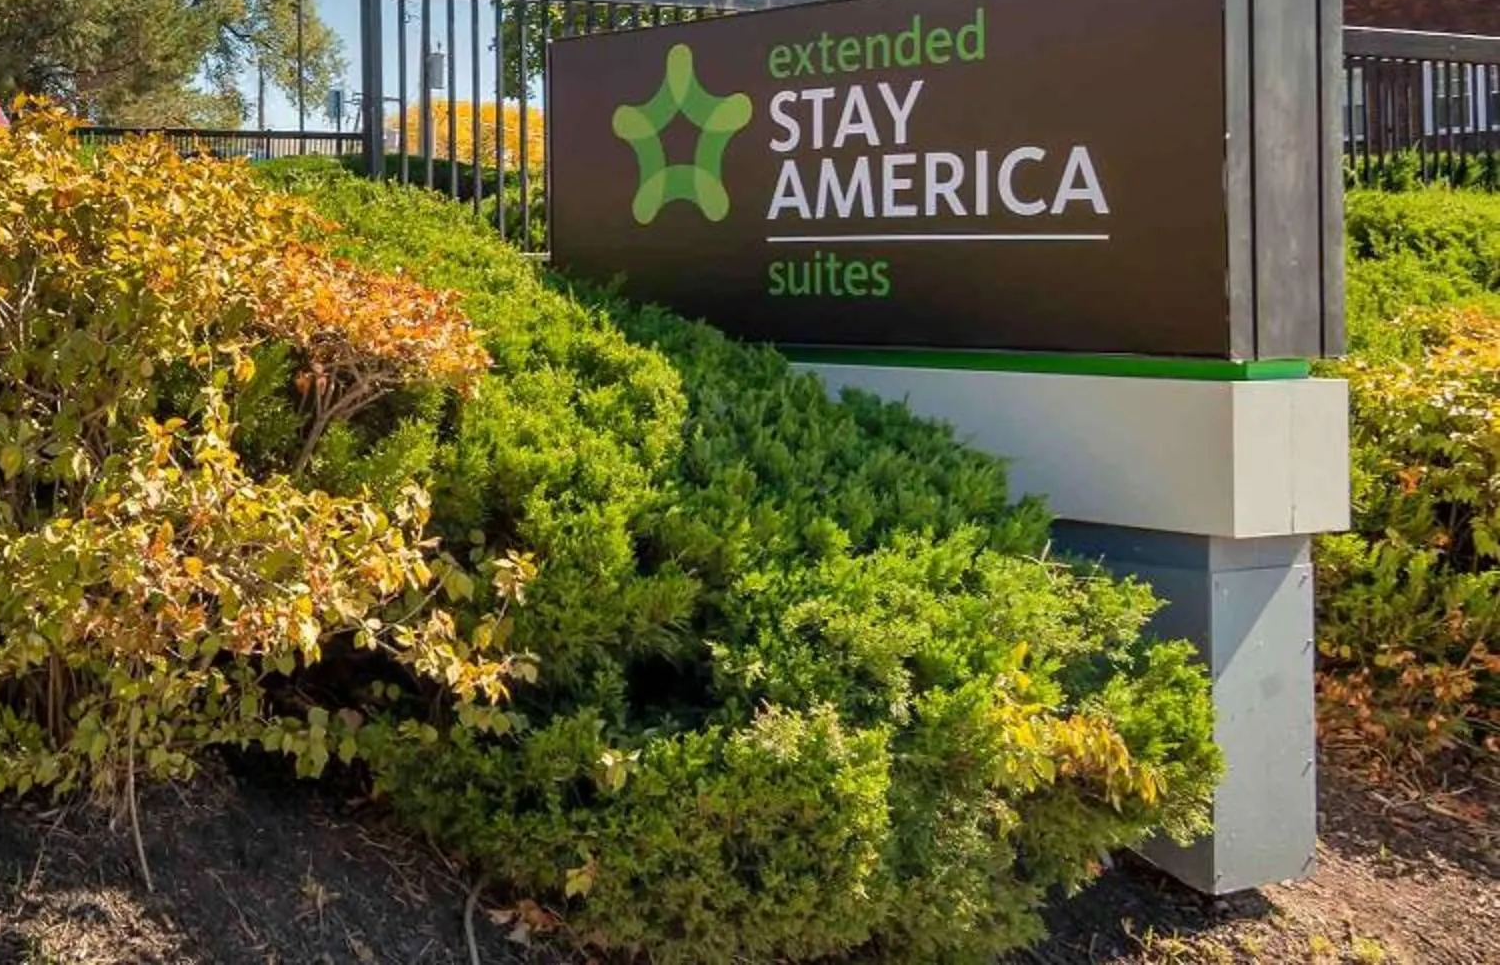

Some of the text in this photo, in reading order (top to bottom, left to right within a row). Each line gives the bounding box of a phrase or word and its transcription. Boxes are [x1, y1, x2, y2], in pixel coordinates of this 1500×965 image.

[768, 8, 986, 79] extended
[769, 80, 924, 152] STAY
[766, 146, 1110, 219] AMERICA
[768, 251, 891, 297] suites
